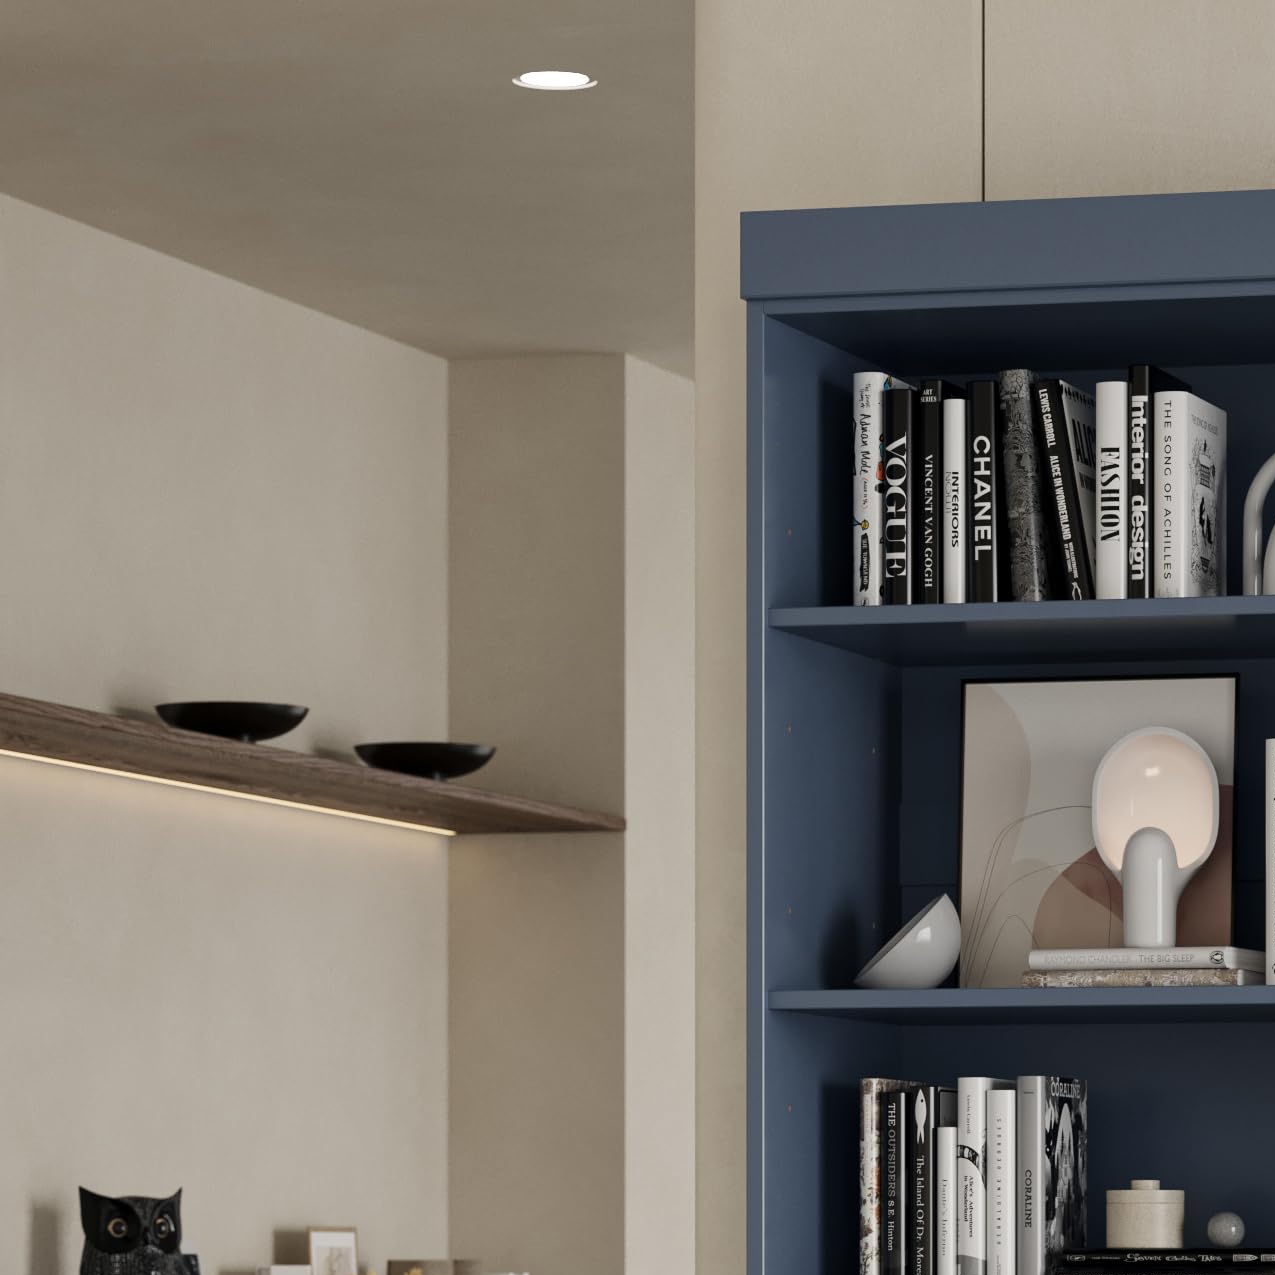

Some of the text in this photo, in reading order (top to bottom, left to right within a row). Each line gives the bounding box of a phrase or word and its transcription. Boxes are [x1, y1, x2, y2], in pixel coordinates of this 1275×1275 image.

[1038, 388, 1057, 449] LEWIS CARROLL
[885, 432, 907, 578] VOGUE
[951, 471, 959, 548] INTERIORS
[973, 435, 992, 561] CHANEL
[1049, 455, 1072, 540] ALICE IN WONDERLAND
[1101, 447, 1121, 542] FASHION
[1129, 395, 1149, 581] Interior design
[1163, 400, 1172, 581] THE SONG OF ACHILLES
[924, 454, 933, 588] VINCENT VAN GOGH
[1137, 953, 1195, 963] THE BIG SLEEP
[888, 1102, 896, 1126] THE
[1050, 1079, 1081, 1099] CORALINE
[887, 1129, 896, 1198] OUTSIDERS
[916, 1154, 925, 1175] The
[916, 1177, 925, 1208] Island
[916, 1209, 925, 1224] Of
[1024, 1169, 1033, 1228] CORALINE
[887, 1221, 895, 1252] Hinton
[916, 1226, 925, 1242] Dr.
